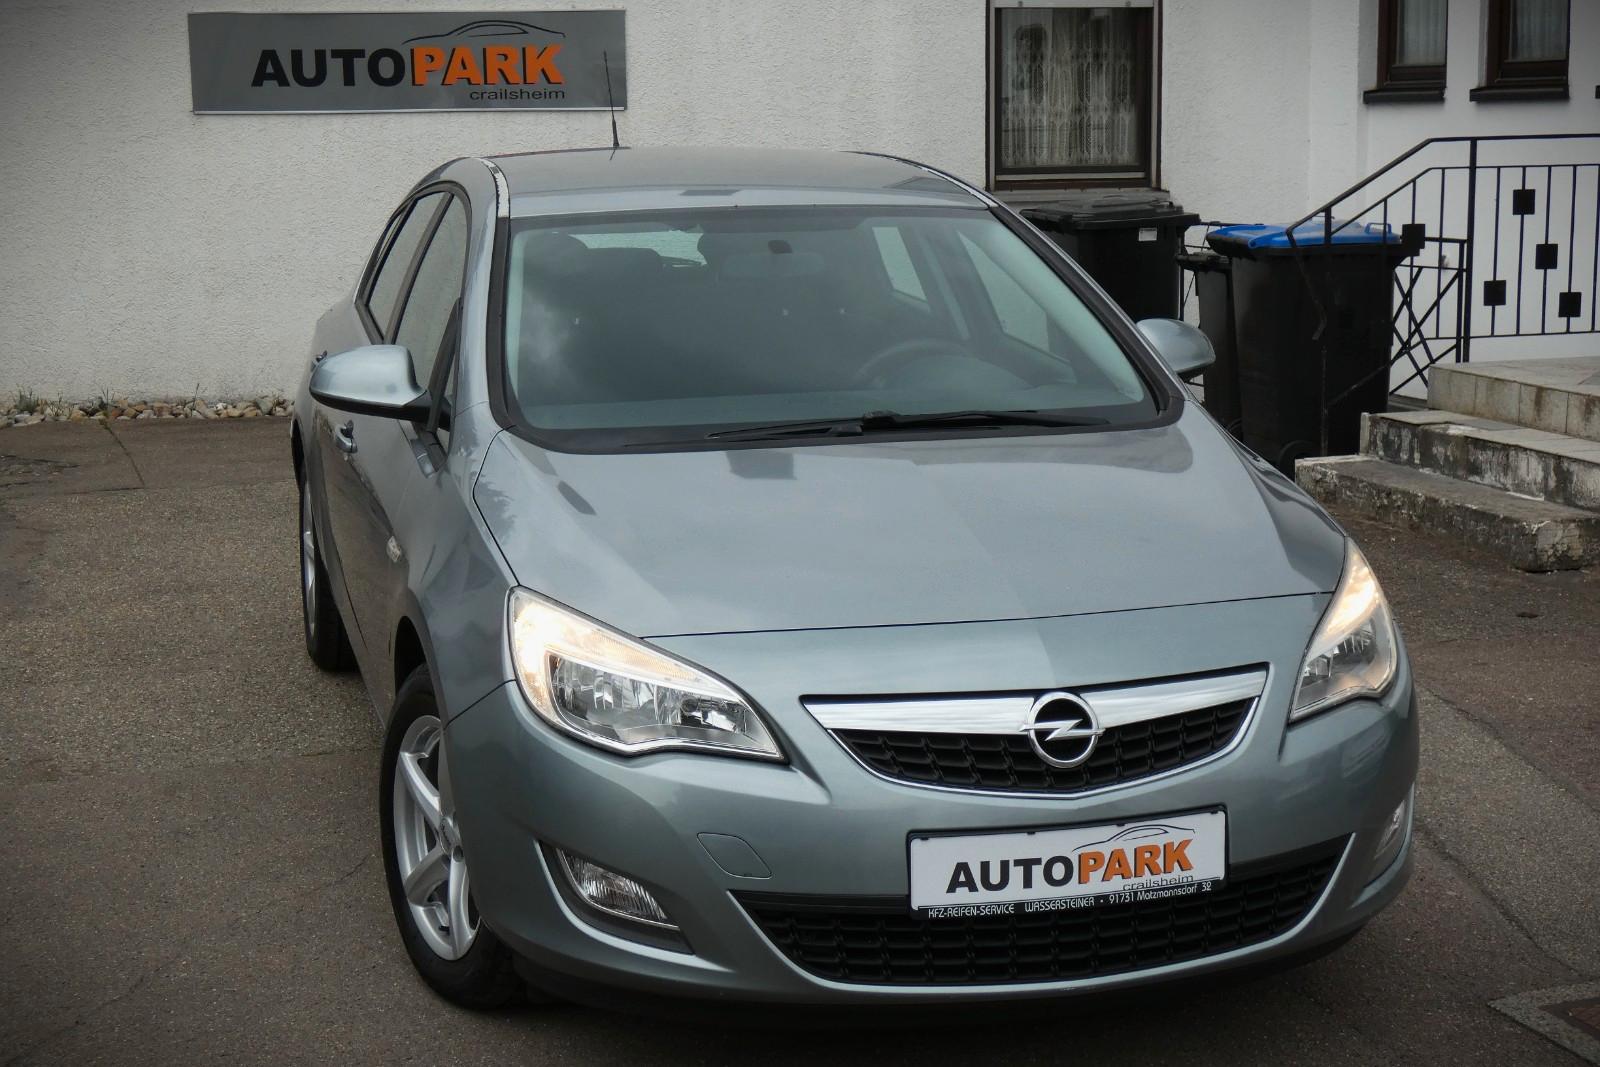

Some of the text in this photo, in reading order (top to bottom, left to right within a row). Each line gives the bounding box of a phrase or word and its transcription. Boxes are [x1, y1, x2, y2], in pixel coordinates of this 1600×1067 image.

[251, 45, 564, 87] AUTOPARK
[469, 88, 566, 101] crailsheim
[945, 839, 1194, 893] AUTOPARK
[1122, 875, 1194, 891] crailsheim
[928, 903, 1015, 918] KFZ-REIFEN-SERVICE
[1024, 897, 1095, 912] WASSERSTEINER
[1108, 892, 1136, 904] 91731
